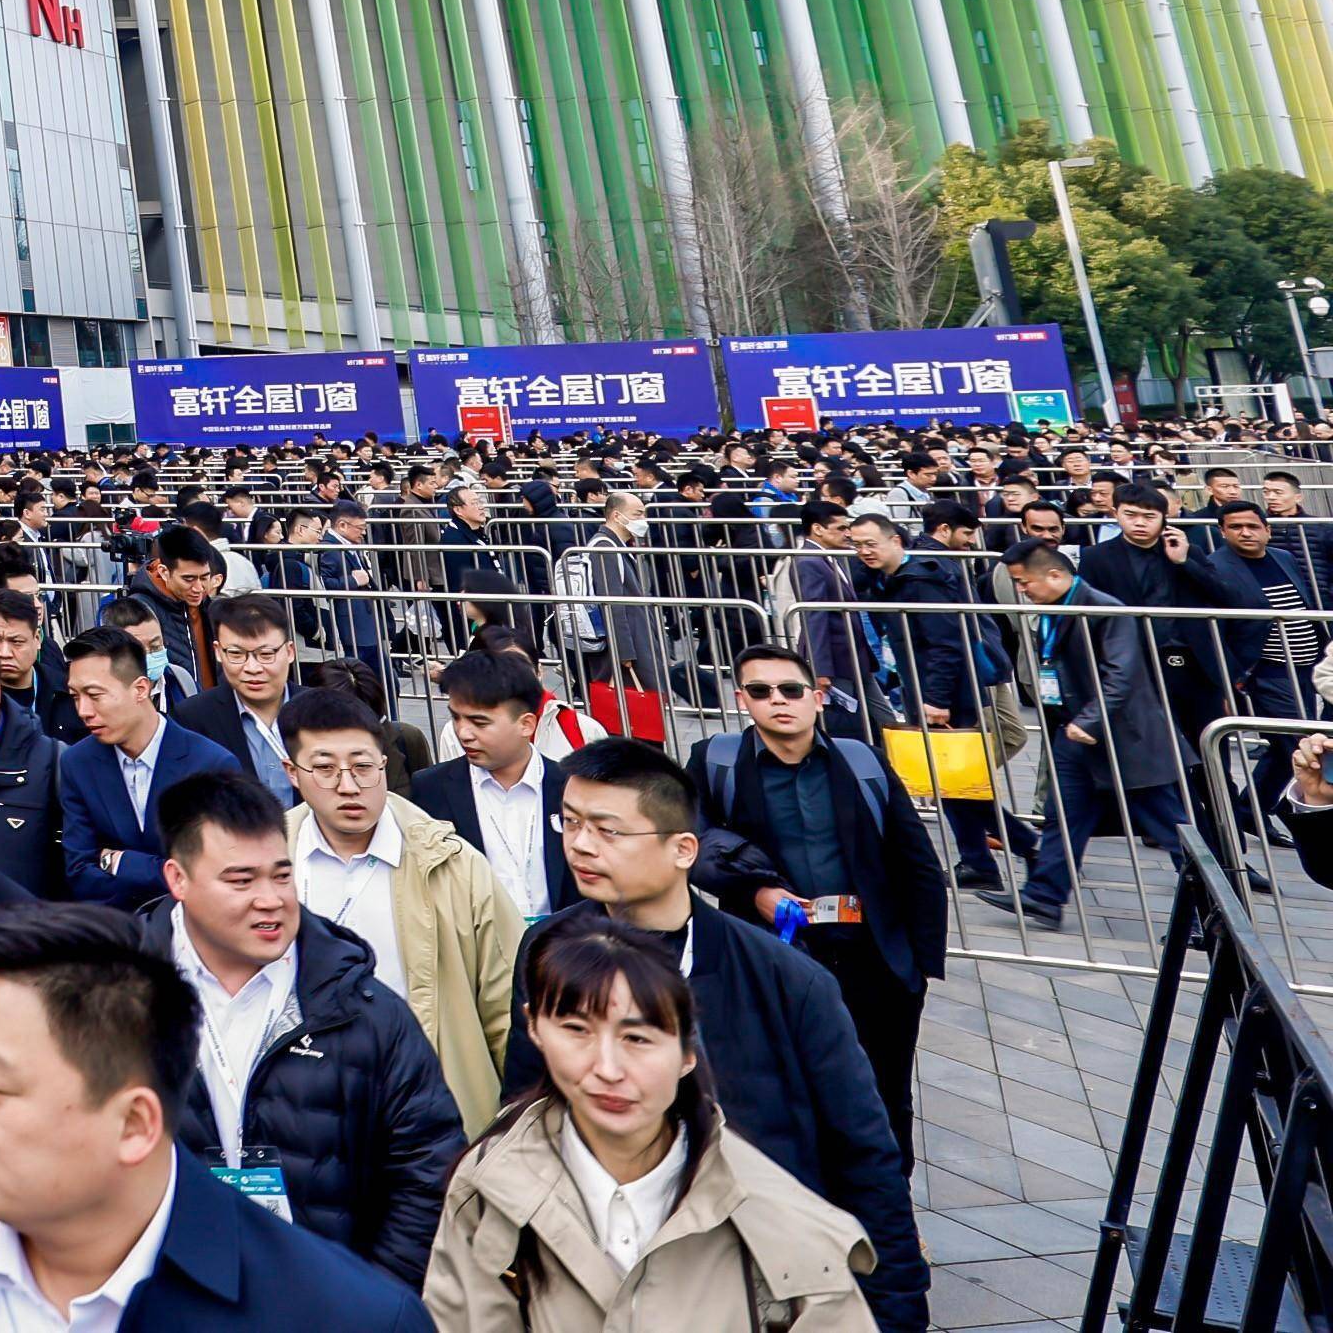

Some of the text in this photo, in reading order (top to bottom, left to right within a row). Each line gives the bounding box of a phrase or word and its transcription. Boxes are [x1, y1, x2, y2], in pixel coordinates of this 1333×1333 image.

[454, 371, 666, 407] 富轩全屋门窗
[773, 359, 1012, 398] 富轩全屋门窗
[170, 382, 358, 417] 富轩全屋门窗
